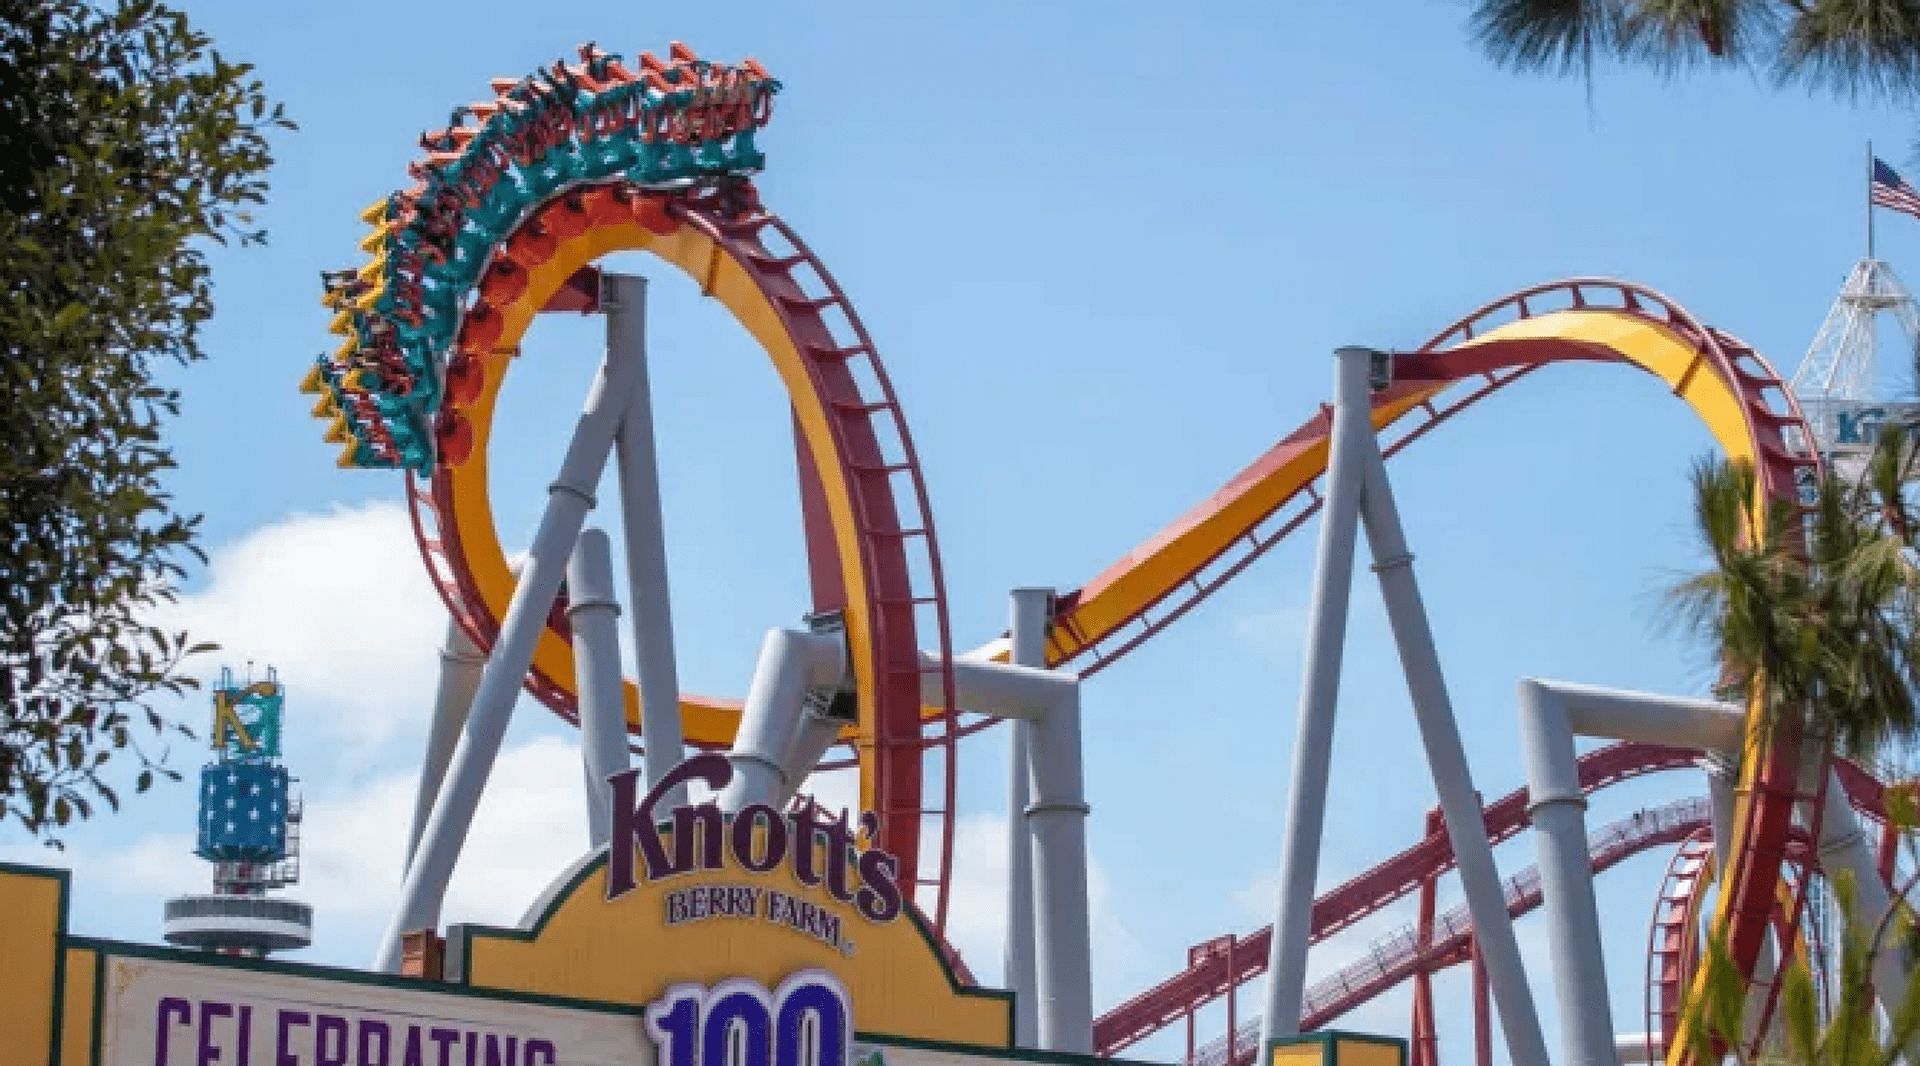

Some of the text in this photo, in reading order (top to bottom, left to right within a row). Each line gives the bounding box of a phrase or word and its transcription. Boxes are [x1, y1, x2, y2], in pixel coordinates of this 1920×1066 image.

[213, 681, 278, 749] K
[607, 754, 902, 922] Knott's
[666, 886, 842, 950] BERRY FARM
[650, 975, 852, 1066] 100
